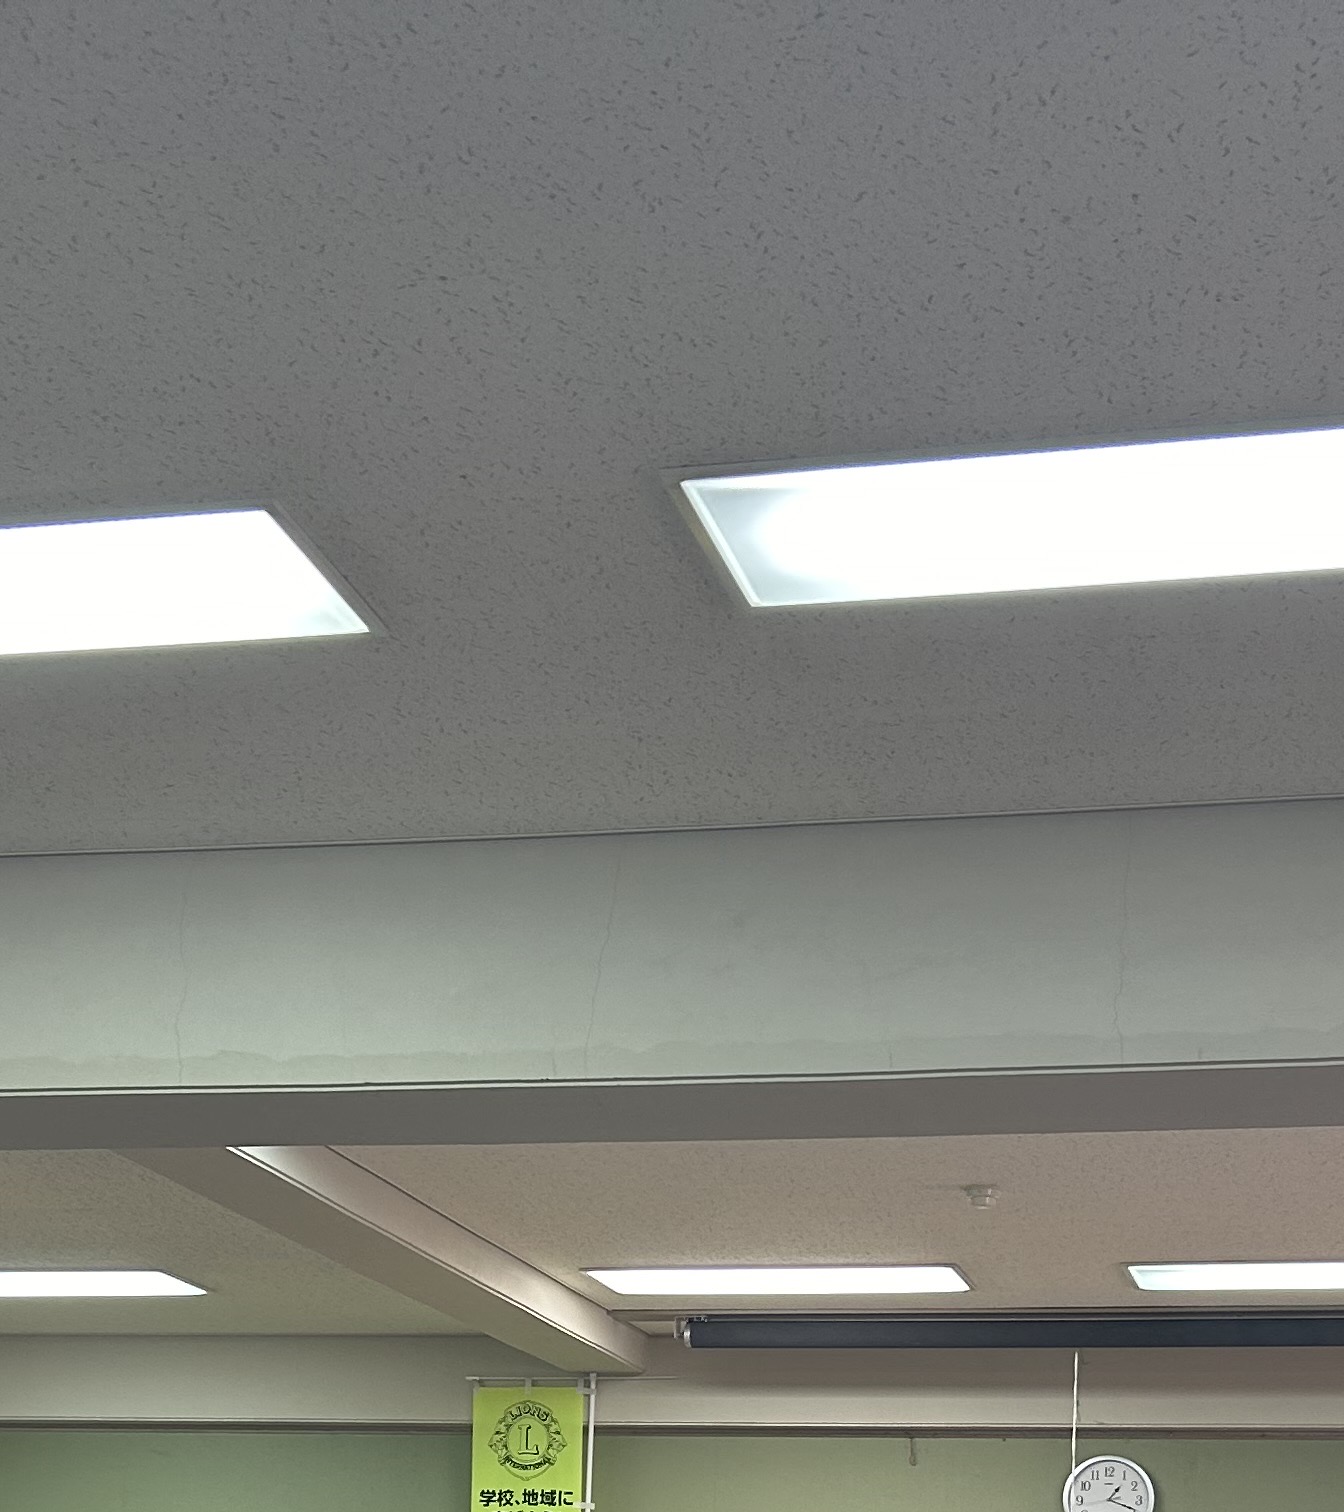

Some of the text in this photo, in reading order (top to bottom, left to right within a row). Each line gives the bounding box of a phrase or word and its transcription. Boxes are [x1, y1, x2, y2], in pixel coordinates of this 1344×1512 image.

[509, 1403, 550, 1422] LIONS
[517, 1423, 540, 1455] L
[1091, 1470, 1100, 1480] 11
[1104, 1466, 1115, 1477] 12
[1080, 1481, 1091, 1491] 10
[1131, 1481, 1138, 1491] 2
[479, 1489, 574, 1507] 学校、地域に
[1076, 1495, 1083, 1506] 9
[1135, 1495, 1143, 1506] 3
